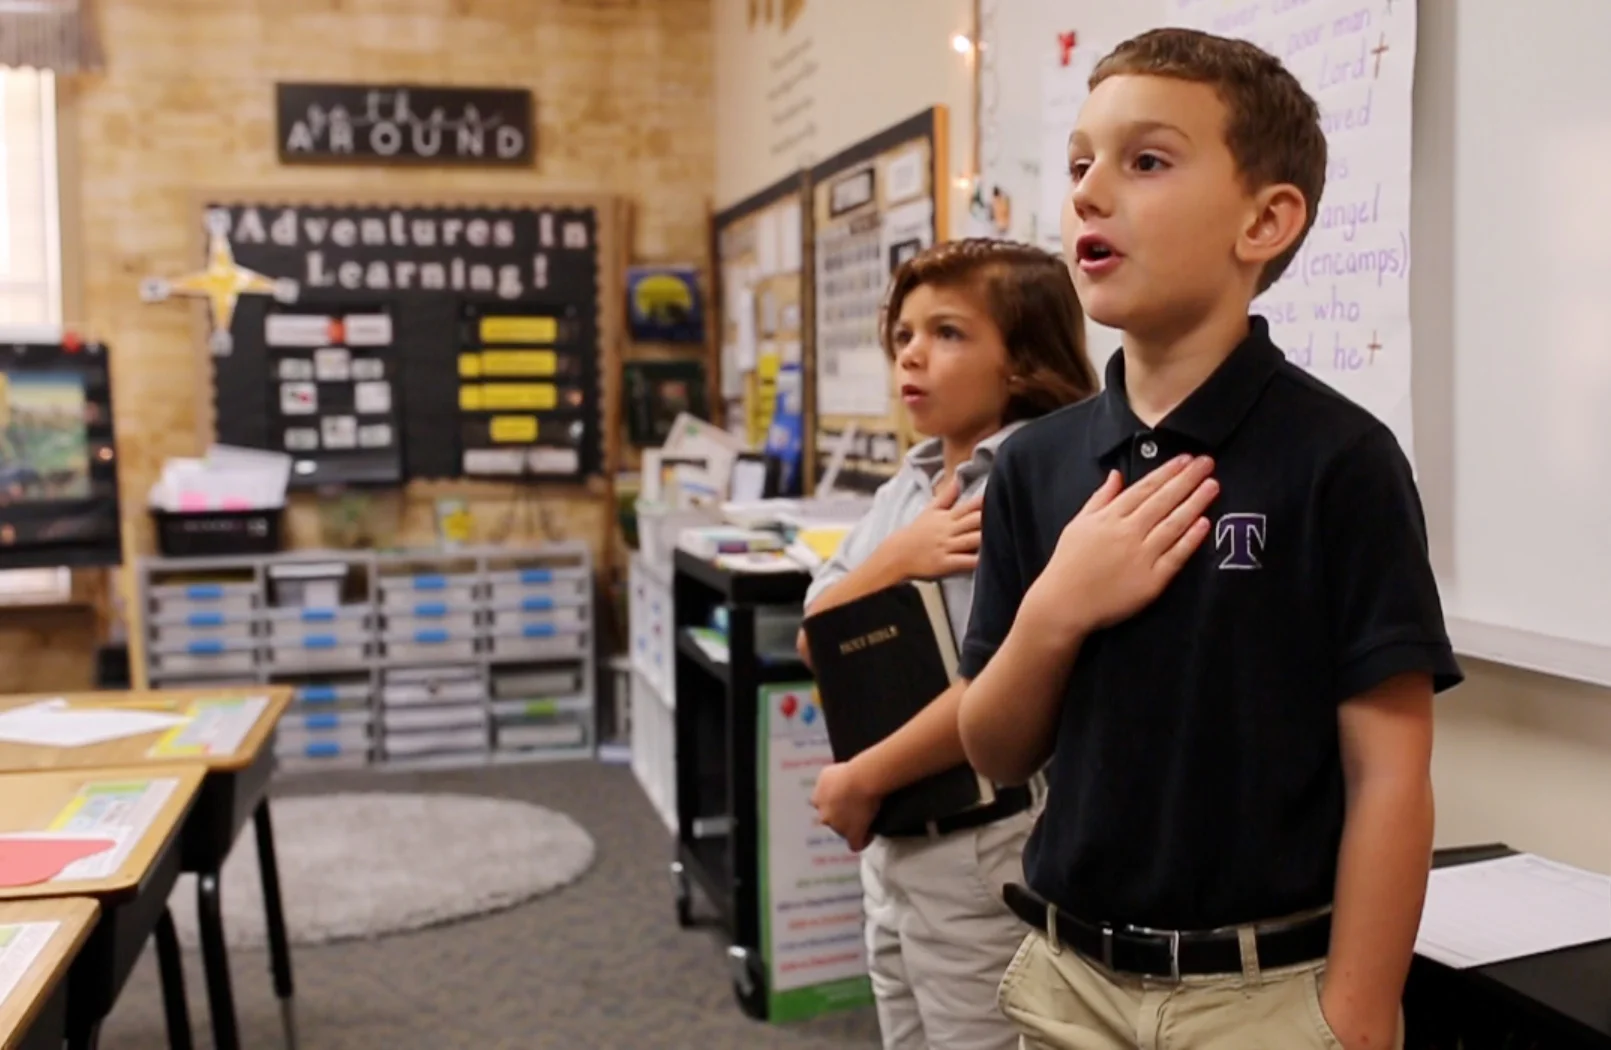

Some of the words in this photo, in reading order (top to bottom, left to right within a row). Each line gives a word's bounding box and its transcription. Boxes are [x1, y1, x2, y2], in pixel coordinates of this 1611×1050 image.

[1318, 36, 1368, 90] Lord
[234, 208, 515, 247] Adventures
[1320, 183, 1381, 242] angel
[305, 250, 550, 299] Learning!
[1314, 284, 1361, 323] who
[1333, 332, 1364, 370] he
[1216, 512, 1266, 569] T
